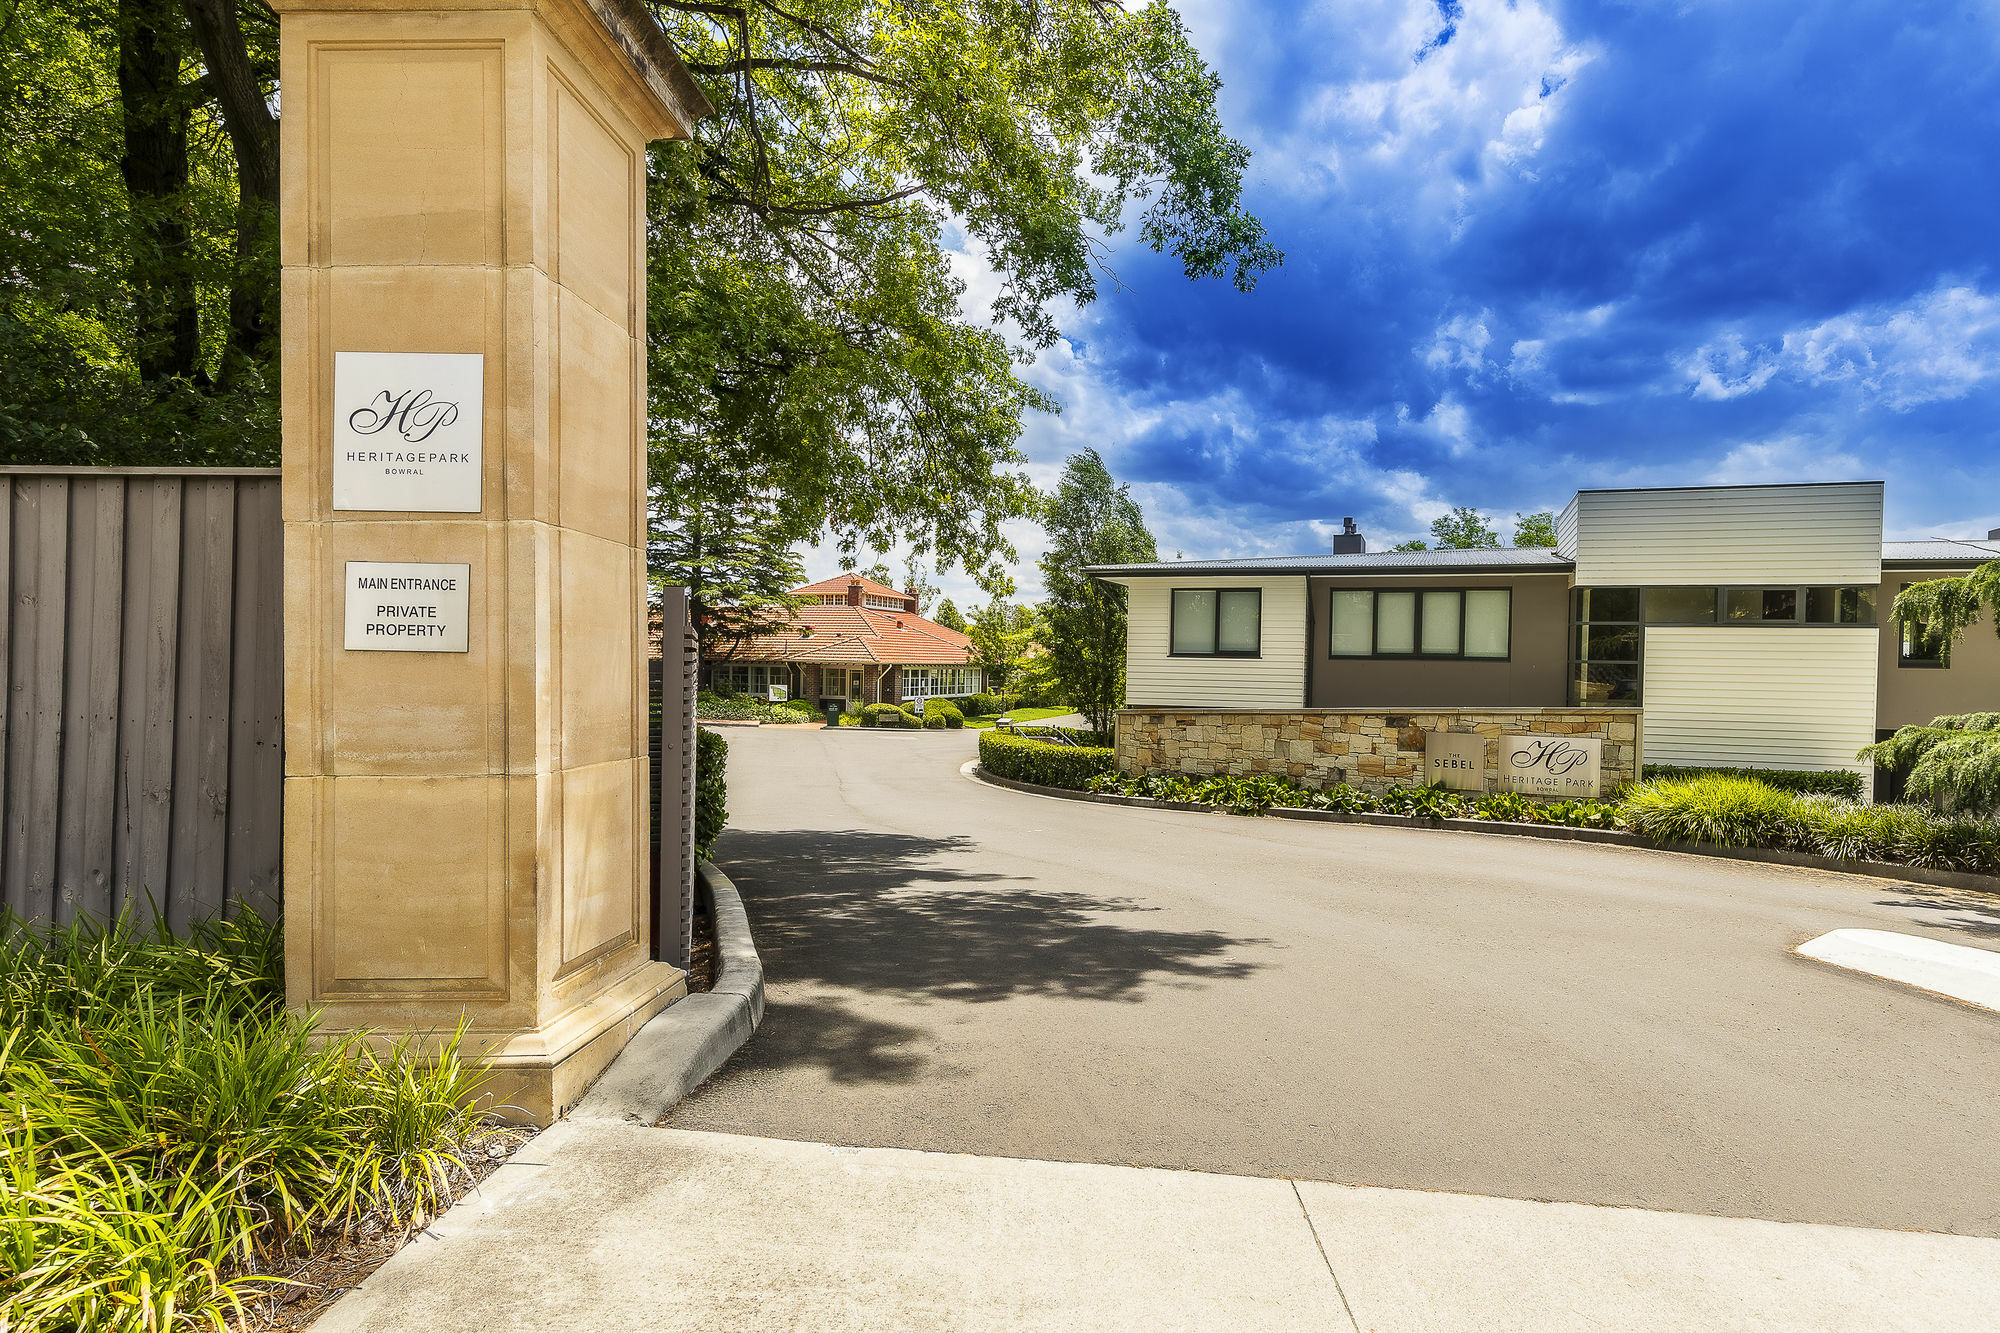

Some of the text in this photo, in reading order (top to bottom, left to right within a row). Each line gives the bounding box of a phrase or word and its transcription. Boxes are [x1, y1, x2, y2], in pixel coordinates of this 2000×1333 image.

[358, 577, 457, 591] MAIN ENTRANCE
[376, 605, 437, 618] PRIVATE
[366, 623, 446, 636] PROPERTY
[1434, 758, 1475, 770] SEBEL
[1503, 774, 1594, 788] HERITAGE PARK
